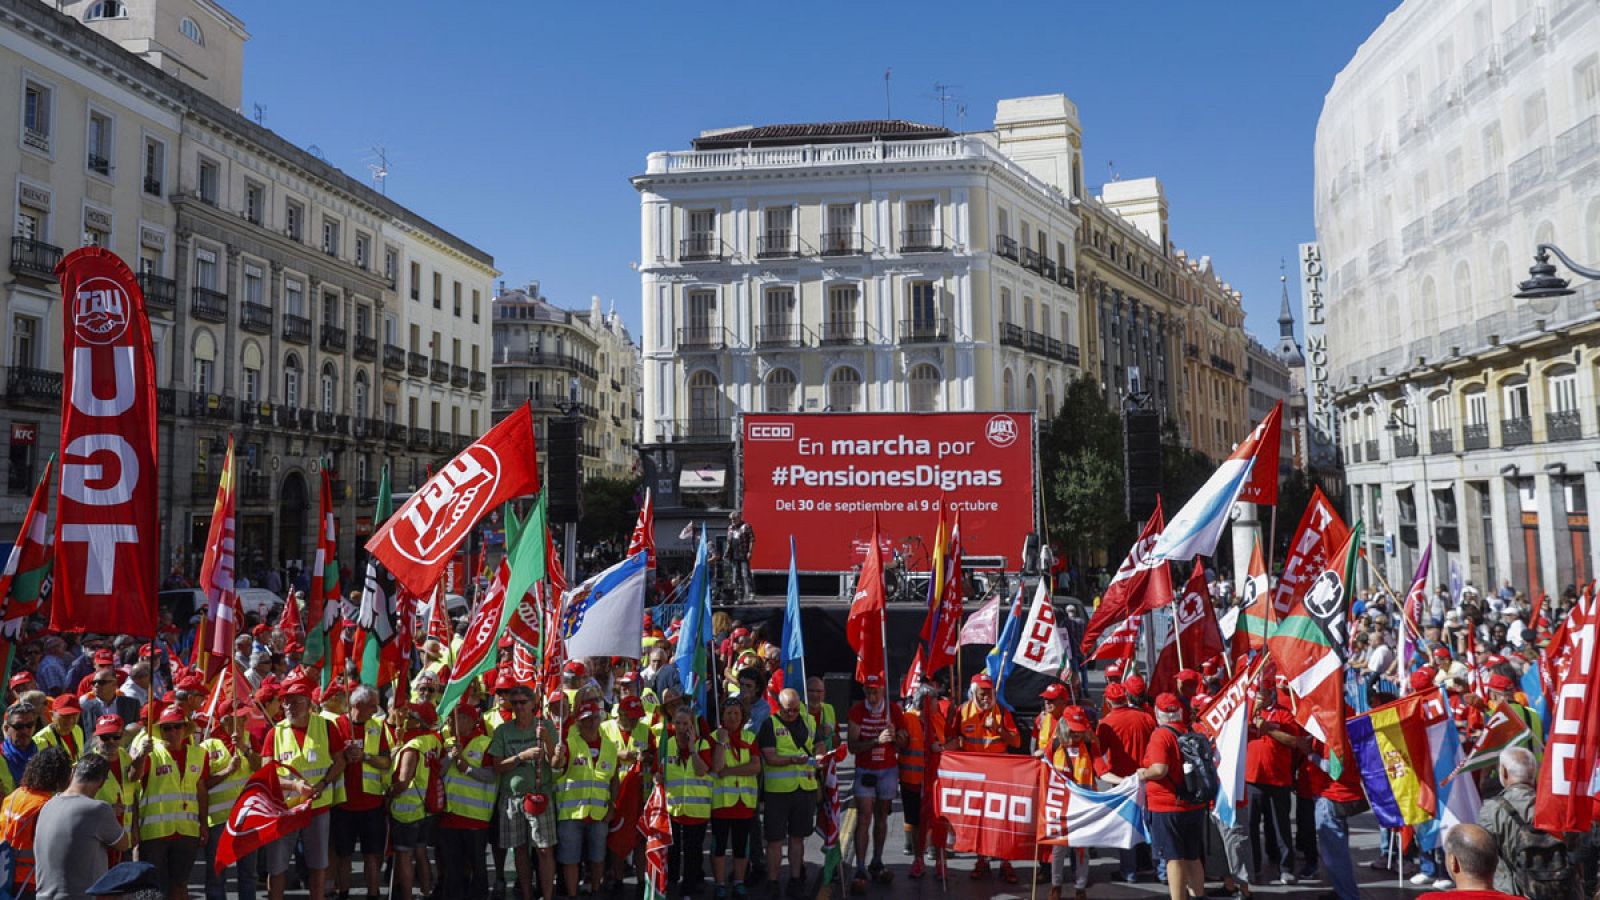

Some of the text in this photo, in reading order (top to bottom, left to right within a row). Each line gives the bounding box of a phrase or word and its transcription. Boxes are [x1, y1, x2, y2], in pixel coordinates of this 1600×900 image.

[88, 212, 110, 227] HOSTAL
[1304, 245, 1333, 445] HOTEL MODERNO
[751, 427, 791, 437] CCOO
[989, 420, 1013, 434] UGT
[14, 429, 34, 440] KFC
[799, 435, 976, 459] En marcha por
[771, 464, 1002, 491] #PensionesDignas
[775, 500, 999, 513] Del 30 de septiembre al 9 d octubre
[156, 765, 173, 776] UGT
[940, 787, 1032, 823] CCOO
